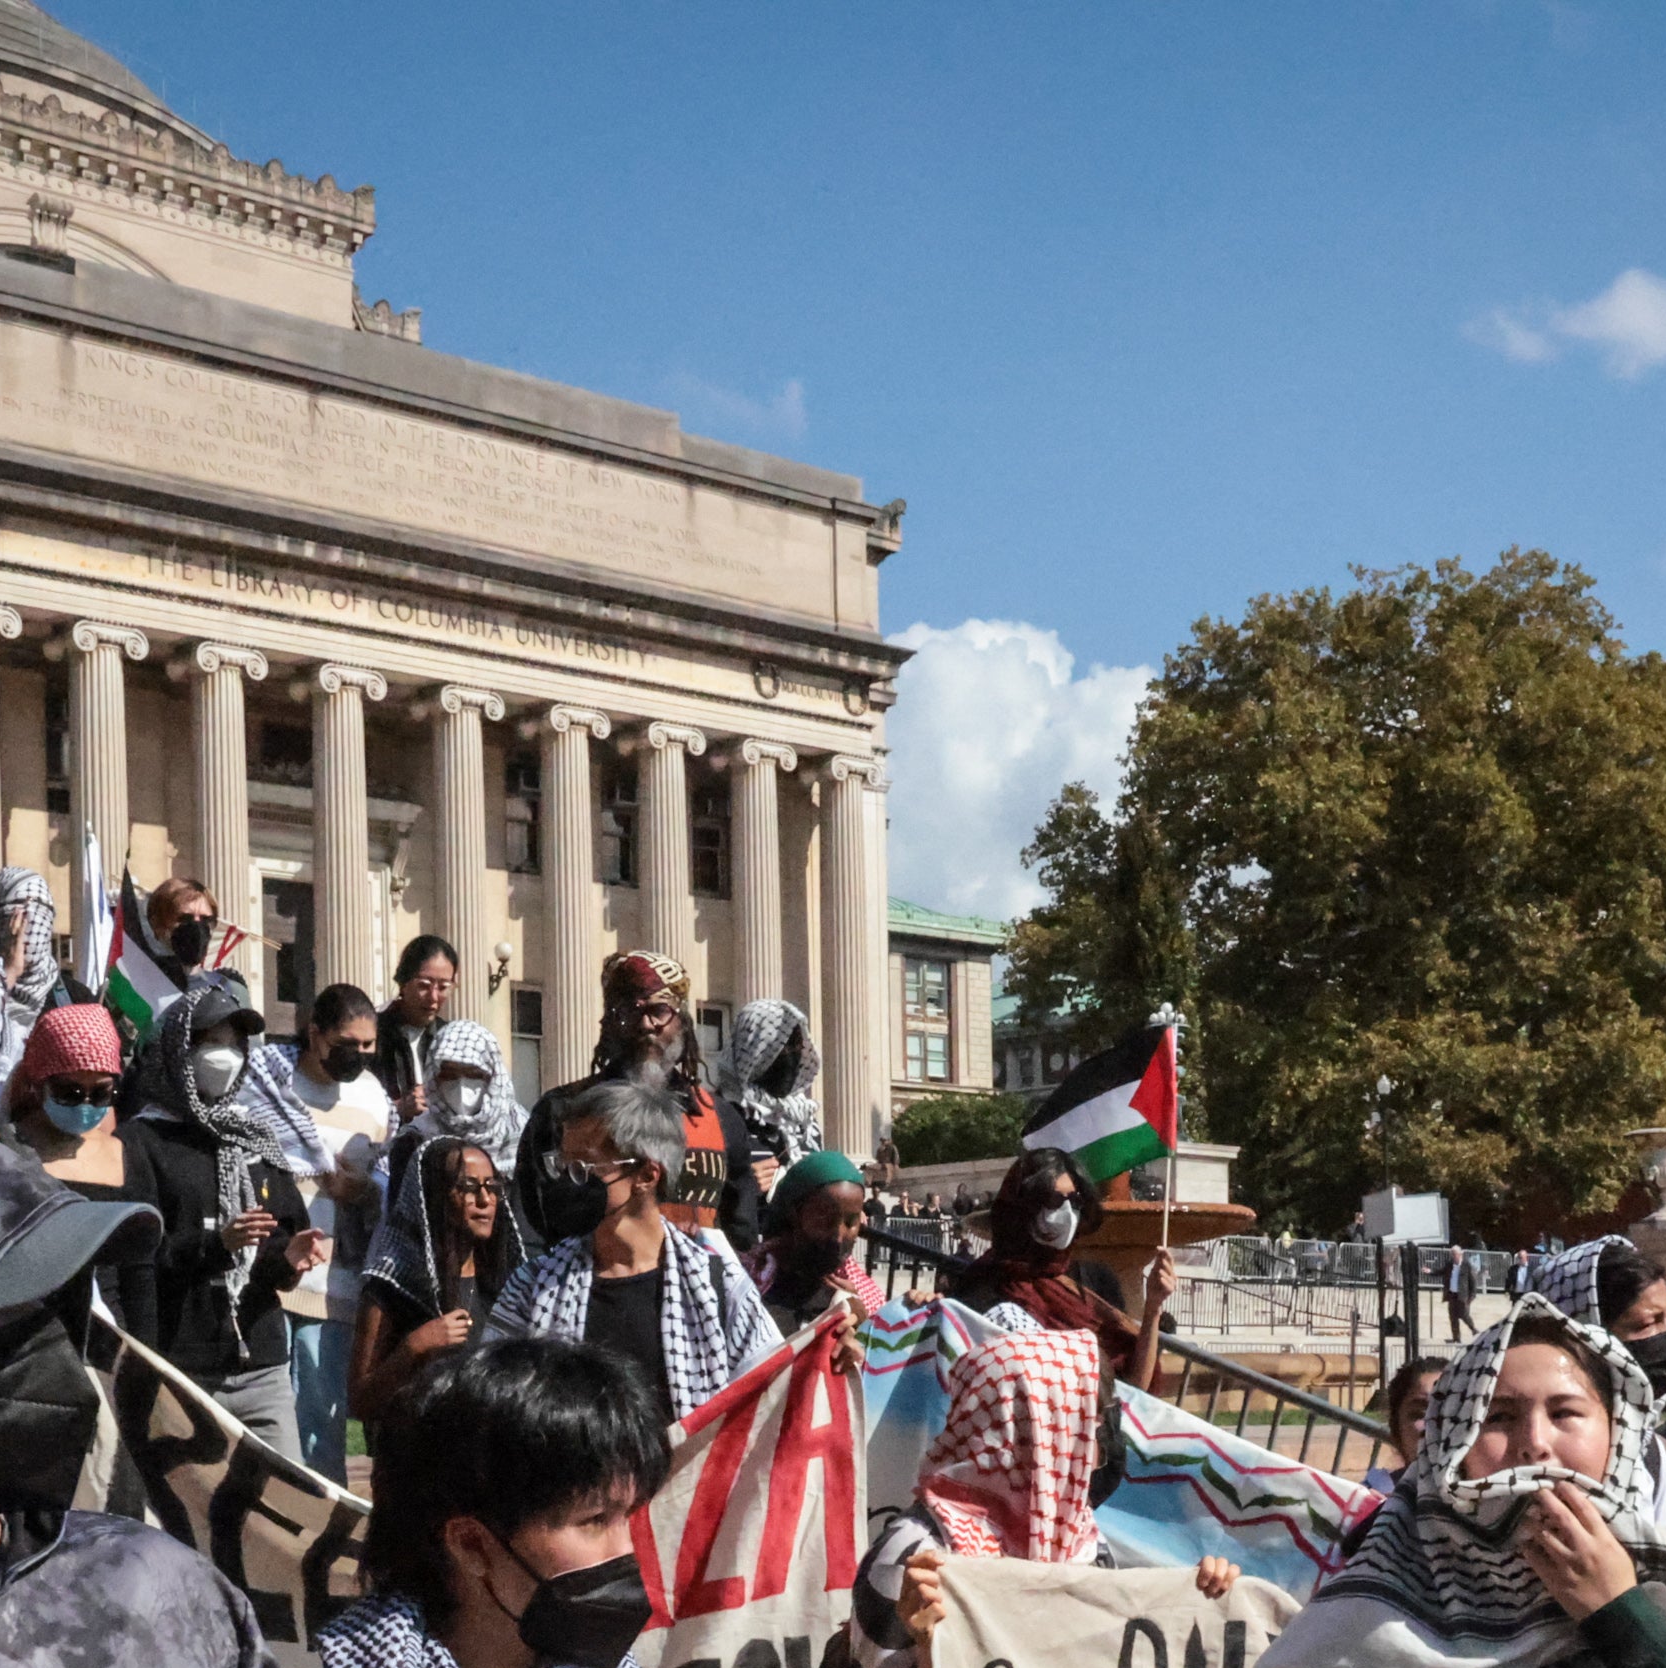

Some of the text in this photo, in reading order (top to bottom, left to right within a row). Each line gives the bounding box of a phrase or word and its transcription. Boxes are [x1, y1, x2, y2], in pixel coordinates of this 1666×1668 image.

[58, 386, 170, 426] PERPETUATED
[203, 417, 300, 456] COLUMBIA
[306, 441, 386, 476] COLLEGE
[418, 469, 446, 489] THE
[453, 476, 502, 502] PEOPLE
[508, 489, 527, 506] OF
[533, 495, 559, 515] THE
[164, 366, 261, 406] COLLEGE
[272, 390, 367, 430] FOUNDED
[379, 416, 397, 438] IN
[406, 423, 445, 450] THE
[456, 435, 546, 474] PROVINCE
[554, 459, 577, 481] OF
[589, 466, 623, 488] NEW
[635, 478, 680, 506] YORK
[245, 409, 291, 435] ROYAL
[300, 421, 366, 451] CHARTER
[374, 440, 389, 454] IN
[397, 444, 422, 463] THE
[434, 453, 473, 475] REIGN
[481, 464, 501, 481] OF
[506, 471, 558, 497] GEORGE
[147, 547, 650, 669] THE LIBRARY OF COLUMBIA UNIVERSITY
[627, 1311, 857, 1634] ZA
